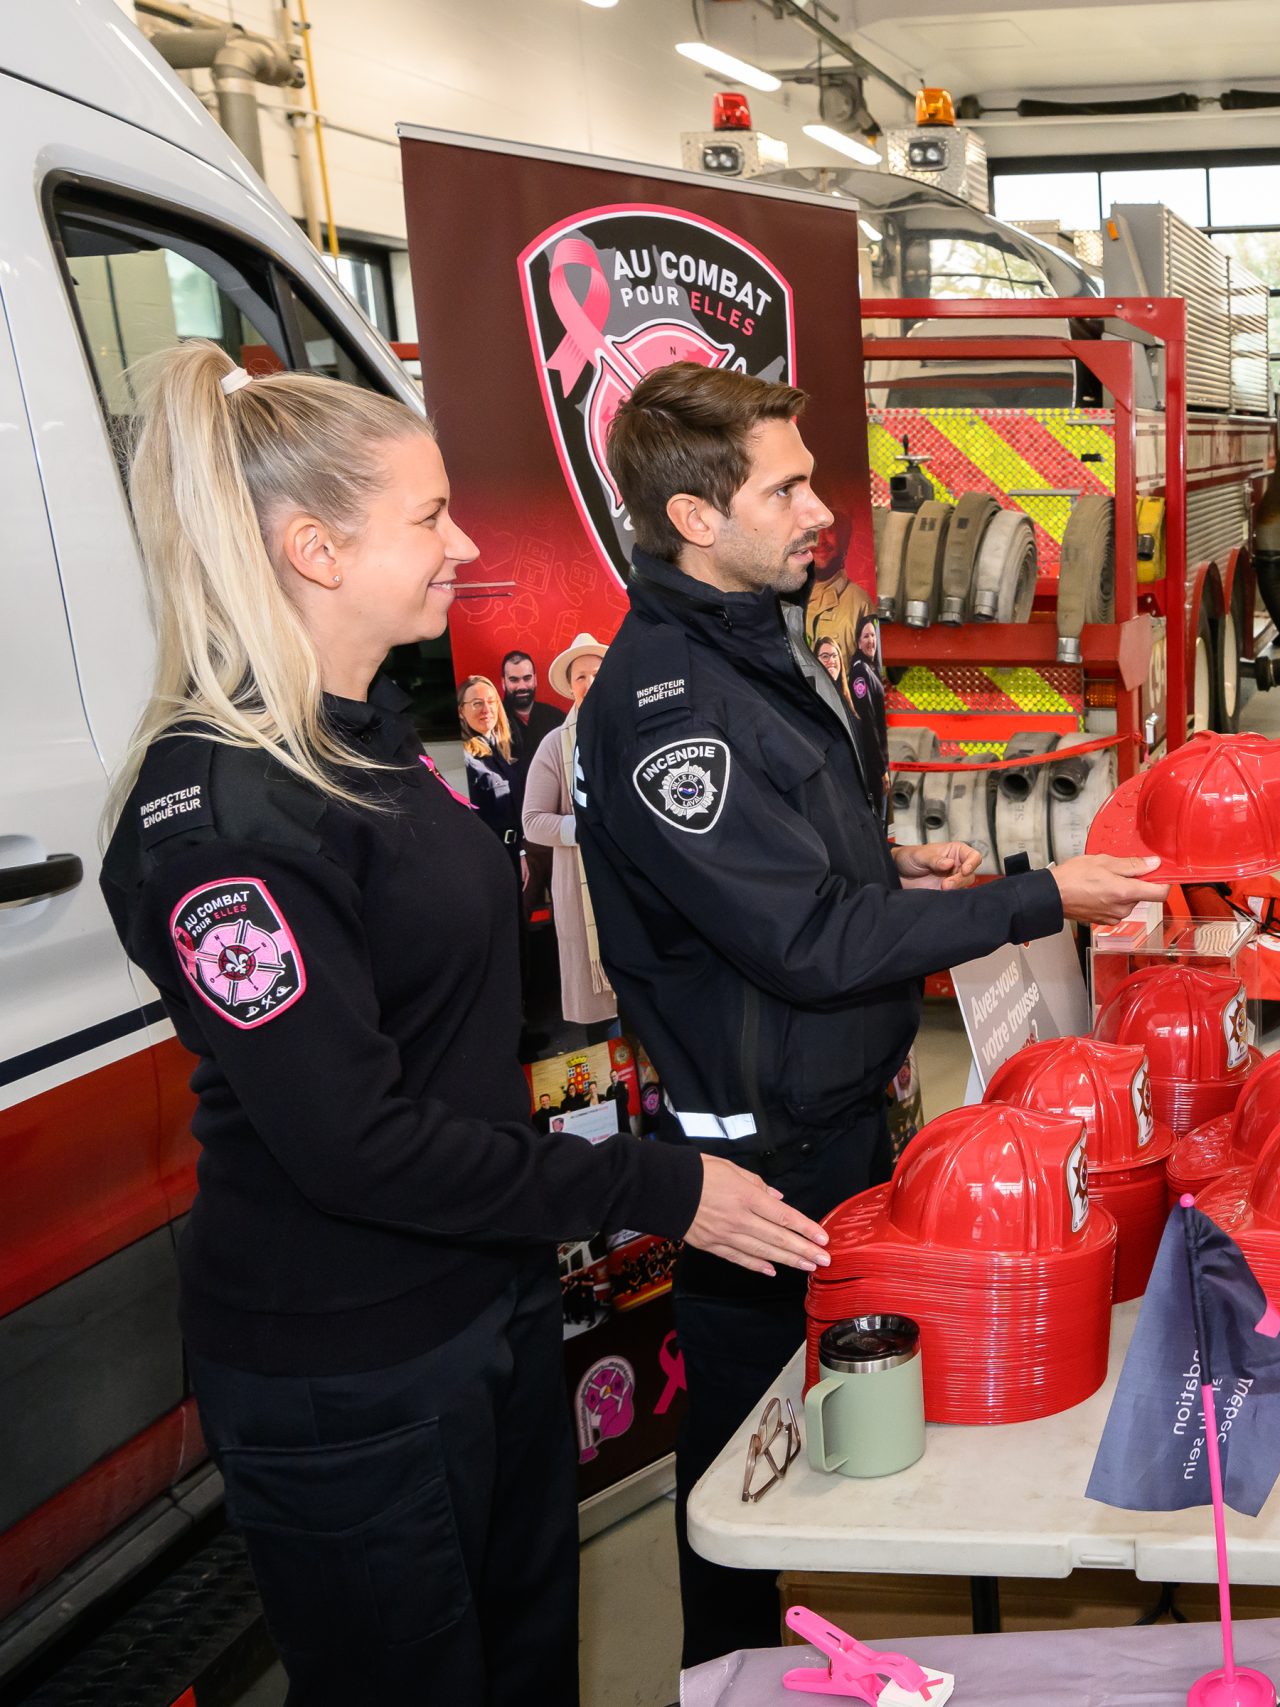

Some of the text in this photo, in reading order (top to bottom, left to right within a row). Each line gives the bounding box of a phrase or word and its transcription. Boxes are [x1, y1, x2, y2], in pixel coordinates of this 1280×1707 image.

[614, 249, 772, 317] AU COMBAT
[620, 285, 755, 336] POUR ELLES
[670, 346, 677, 356] N
[636, 678, 685, 698] INSPECTEUR
[638, 687, 685, 707] ENQUÊTEUR
[642, 745, 716, 782] INCENDIE
[671, 774, 699, 790] VILLE DE
[140, 785, 201, 816] INSPECTEUR
[143, 798, 202, 829] ENQUÊTEUR
[682, 796, 703, 807] LAVAL
[184, 890, 250, 931] AU COMBAT
[191, 903, 247, 937] POUR ELLES
[971, 960, 1019, 1030] Avez-vous
[981, 1021, 1010, 1066] votre
[1007, 982, 1040, 1033] trousse
